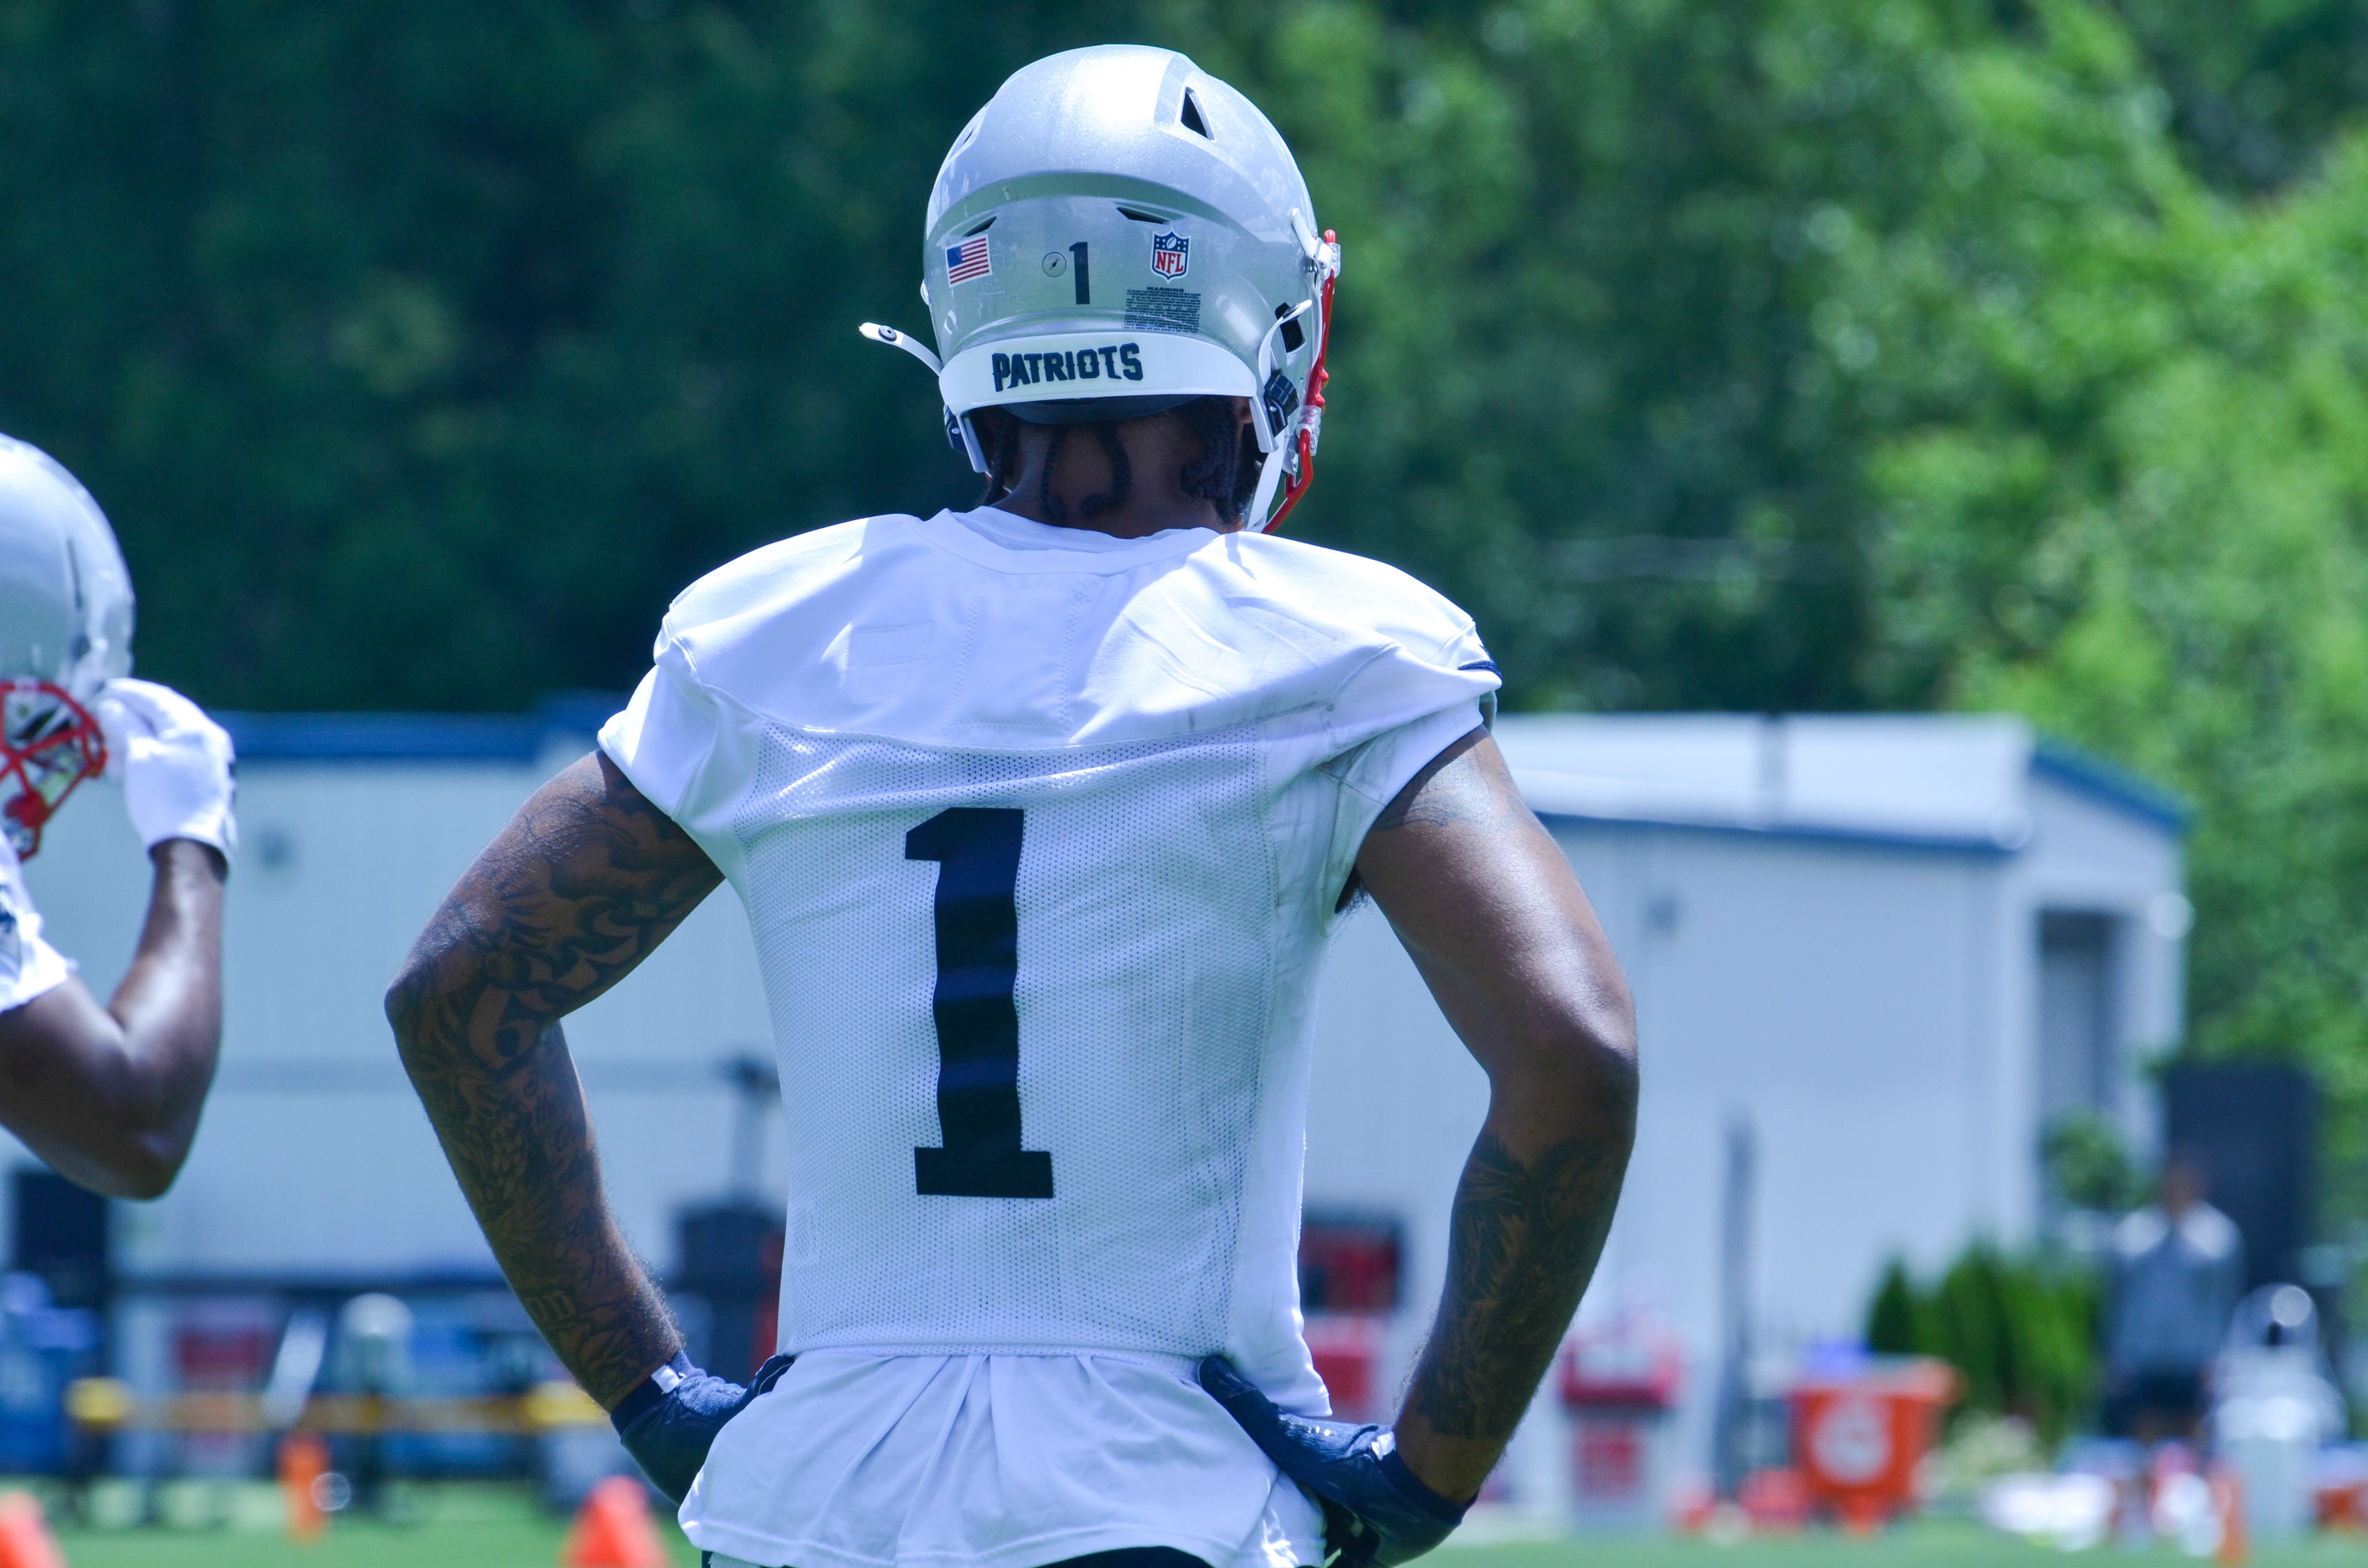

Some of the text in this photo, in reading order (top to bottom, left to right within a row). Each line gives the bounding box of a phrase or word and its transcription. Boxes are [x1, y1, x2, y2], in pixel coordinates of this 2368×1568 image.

[1069, 242, 1090, 305] 1
[1155, 251, 1184, 274] NFL
[992, 343, 1144, 392] PATRIOTS
[905, 807, 1053, 1198] 1
